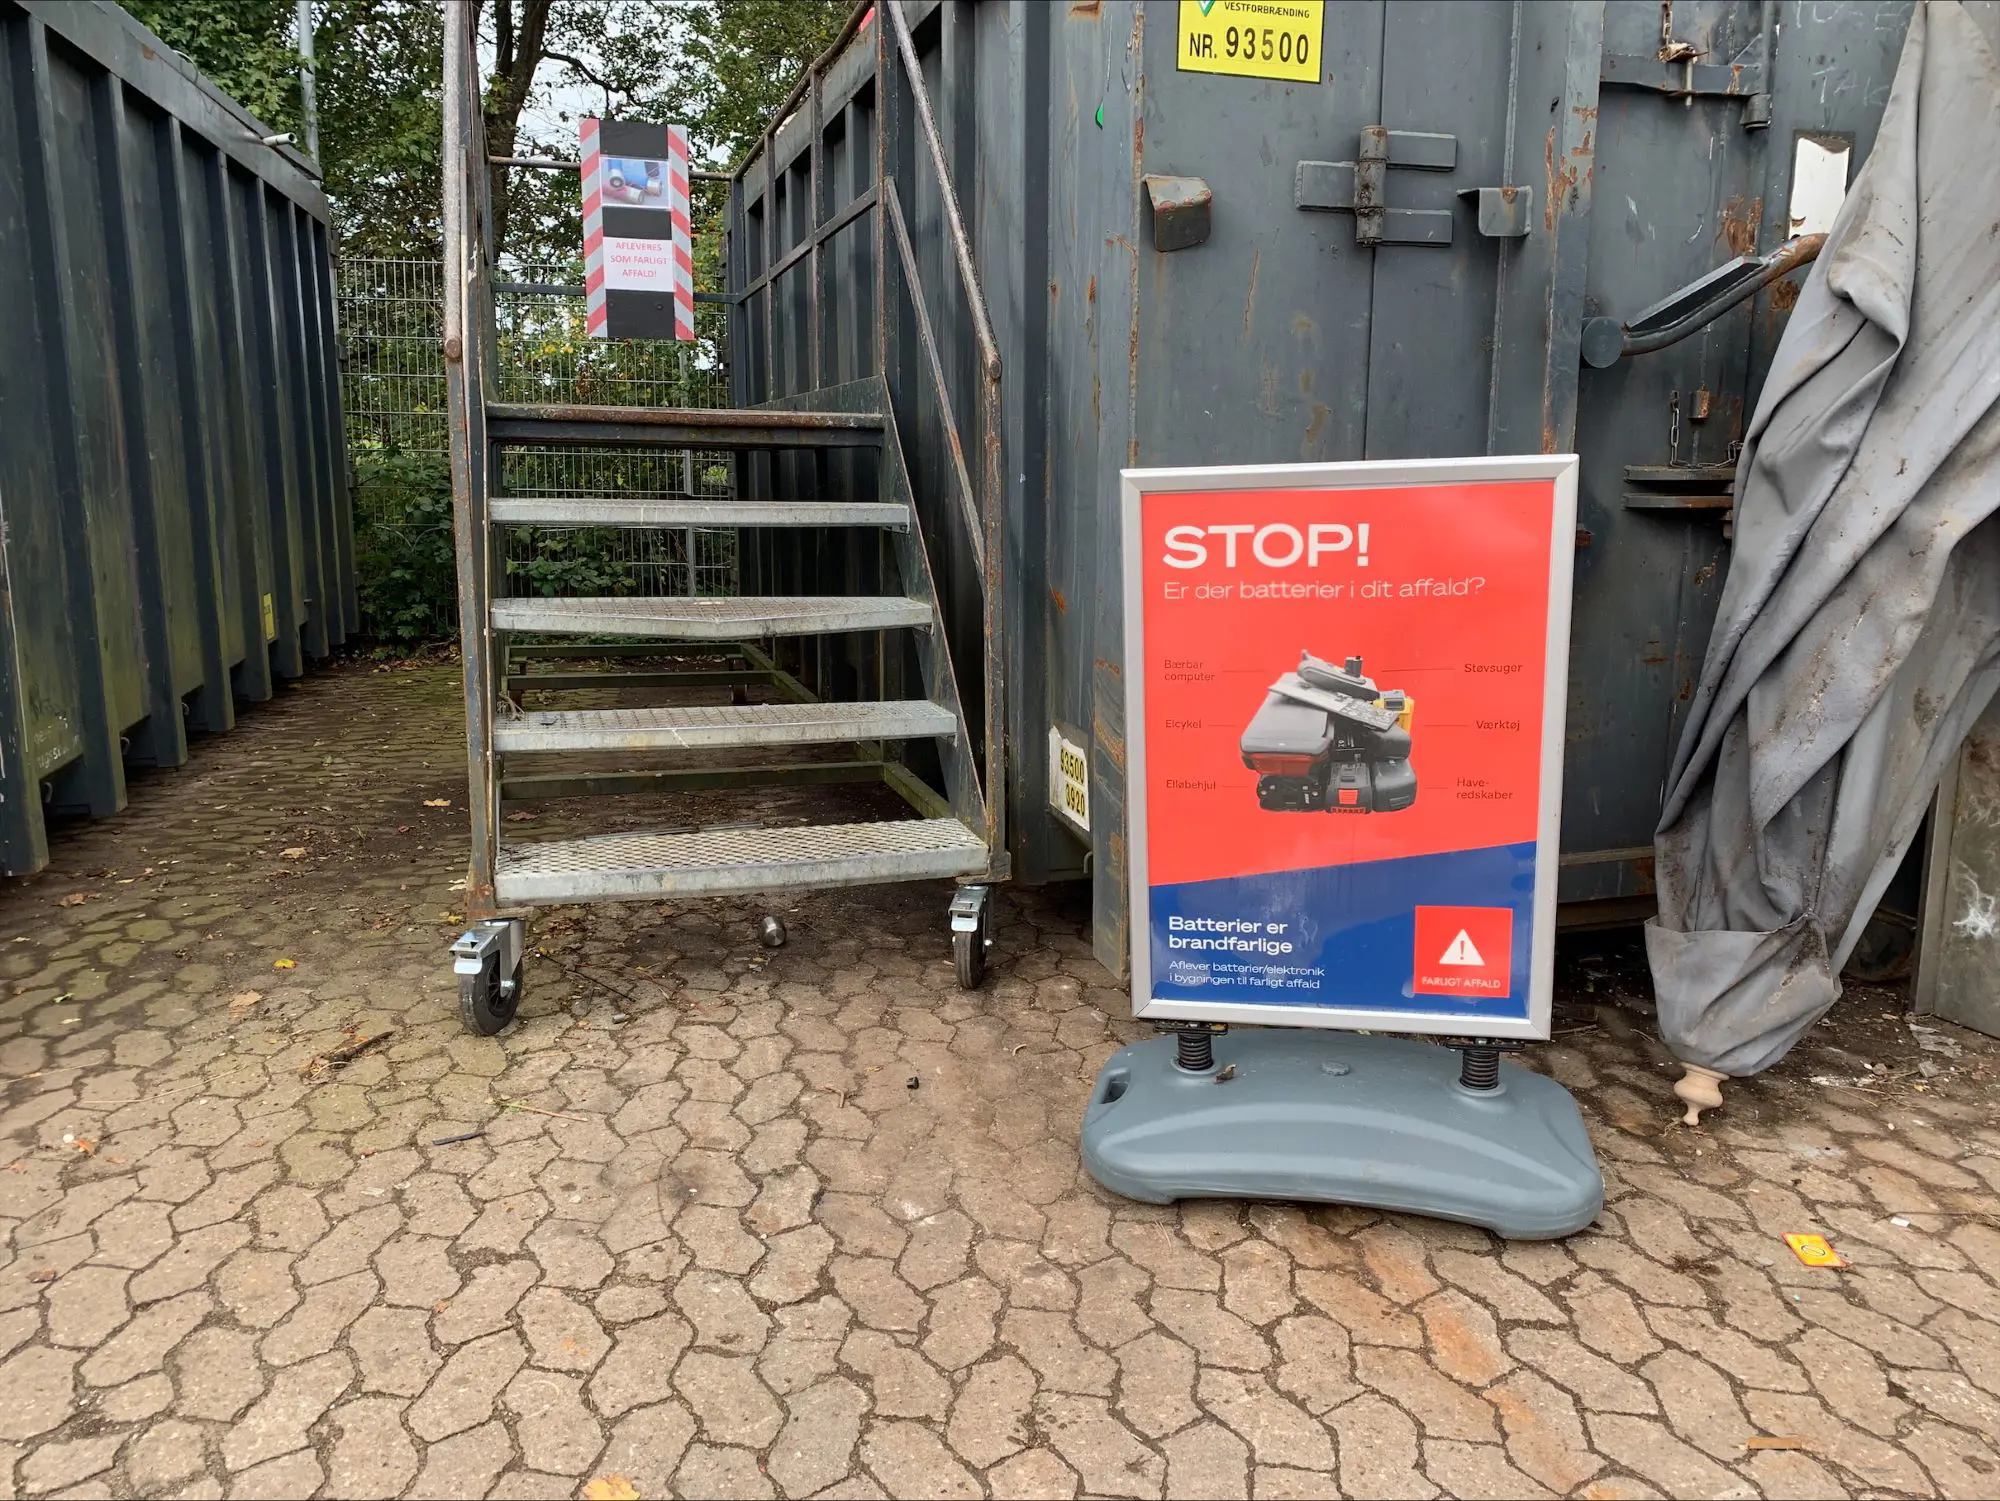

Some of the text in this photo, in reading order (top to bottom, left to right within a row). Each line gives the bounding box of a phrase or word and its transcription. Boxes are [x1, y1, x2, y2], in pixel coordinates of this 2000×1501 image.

[1224, 2, 1310, 19] VESTFORBRÆNDING
[1189, 26, 1309, 65] NR. 93500
[615, 242, 662, 251] AFLEVERES
[610, 255, 667, 265] SOM FARLIGT
[622, 269, 657, 278] AFFALD!
[1162, 523, 1369, 569] STOP!
[1164, 582, 1188, 600] Er
[1195, 581, 1233, 600] der
[1240, 580, 1343, 599] batterier
[1360, 579, 1393, 599] dit
[1399, 576, 1486, 598] affald?
[1164, 659, 1203, 669] Bærbar
[1464, 663, 1522, 675] Støvsuger
[1164, 672, 1215, 683] computer
[1165, 719, 1202, 730] Elcykel
[1476, 720, 1520, 732] Værktøj
[1060, 748, 1085, 784] 93500
[1166, 779, 1216, 791] Elløbehjul
[1456, 777, 1489, 788] Have-
[1065, 783, 1085, 817] 3920
[1456, 789, 1513, 800] redskaber
[1168, 916, 1288, 934] Batterier er
[1168, 934, 1293, 956] brandfarlige
[1168, 960, 1325, 977] Aflever batterier/elektronik
[1174, 973, 1235, 986] bygningen
[1237, 975, 1248, 985] til
[1249, 976, 1284, 989] farligt
[1286, 978, 1320, 989] affald
[1422, 976, 1501, 989] FARLIGT AFFALD
